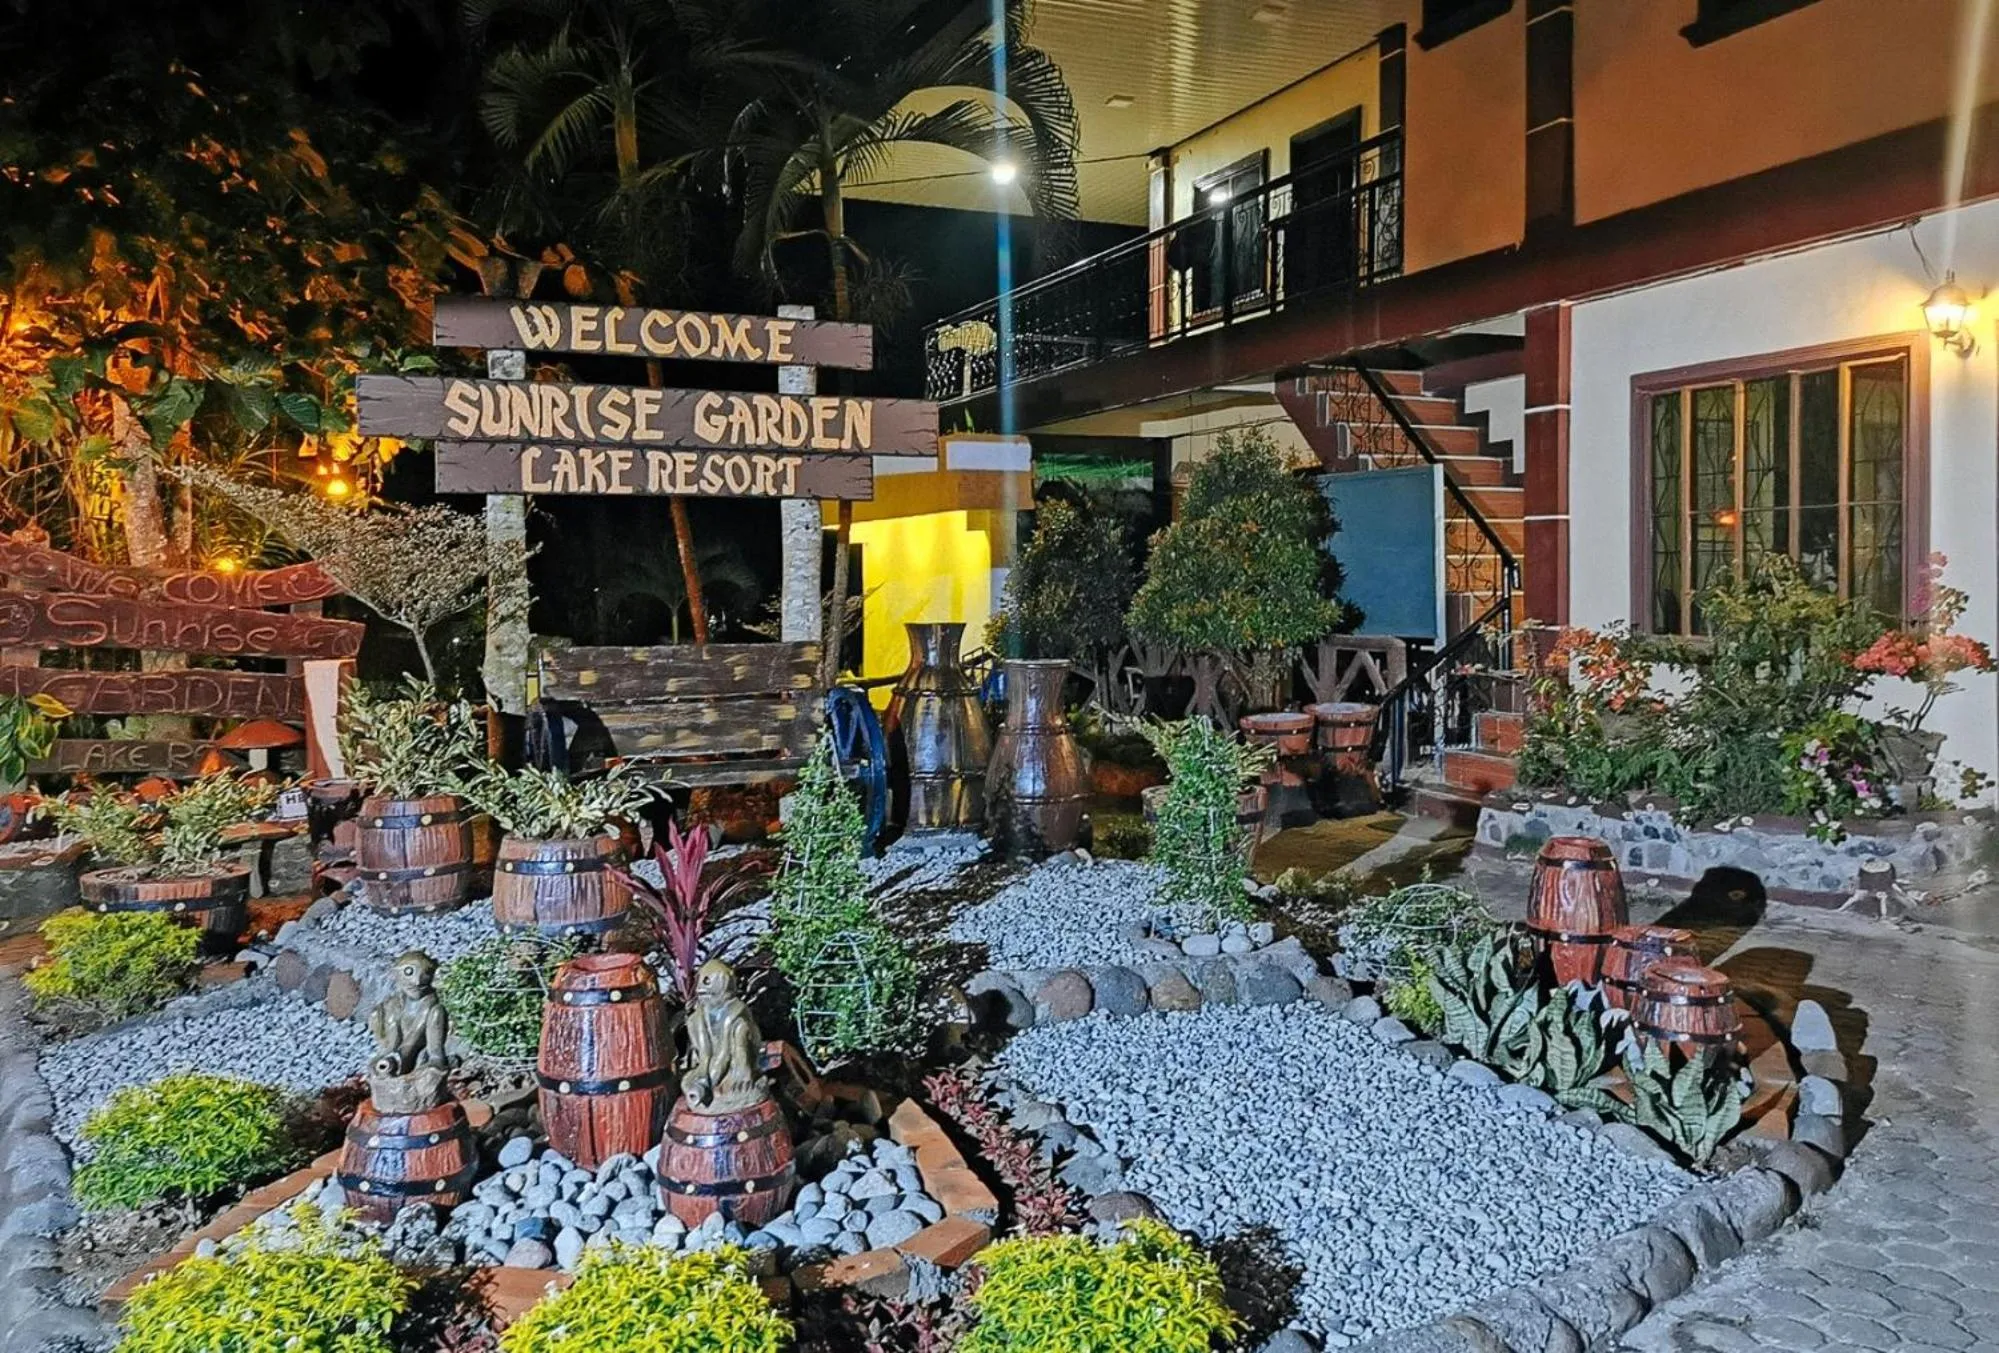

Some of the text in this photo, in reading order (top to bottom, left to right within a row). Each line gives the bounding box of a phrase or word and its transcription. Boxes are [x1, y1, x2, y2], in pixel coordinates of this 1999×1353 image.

[511, 305, 796, 362] WELCOME
[444, 380, 873, 450] SUNRISE GARDEN
[520, 447, 801, 496] LAKE RESORT
[67, 561, 279, 602] WECOME
[47, 599, 278, 652] Sunrise
[40, 672, 293, 716] GARDEN
[60, 743, 150, 771] LAKE
